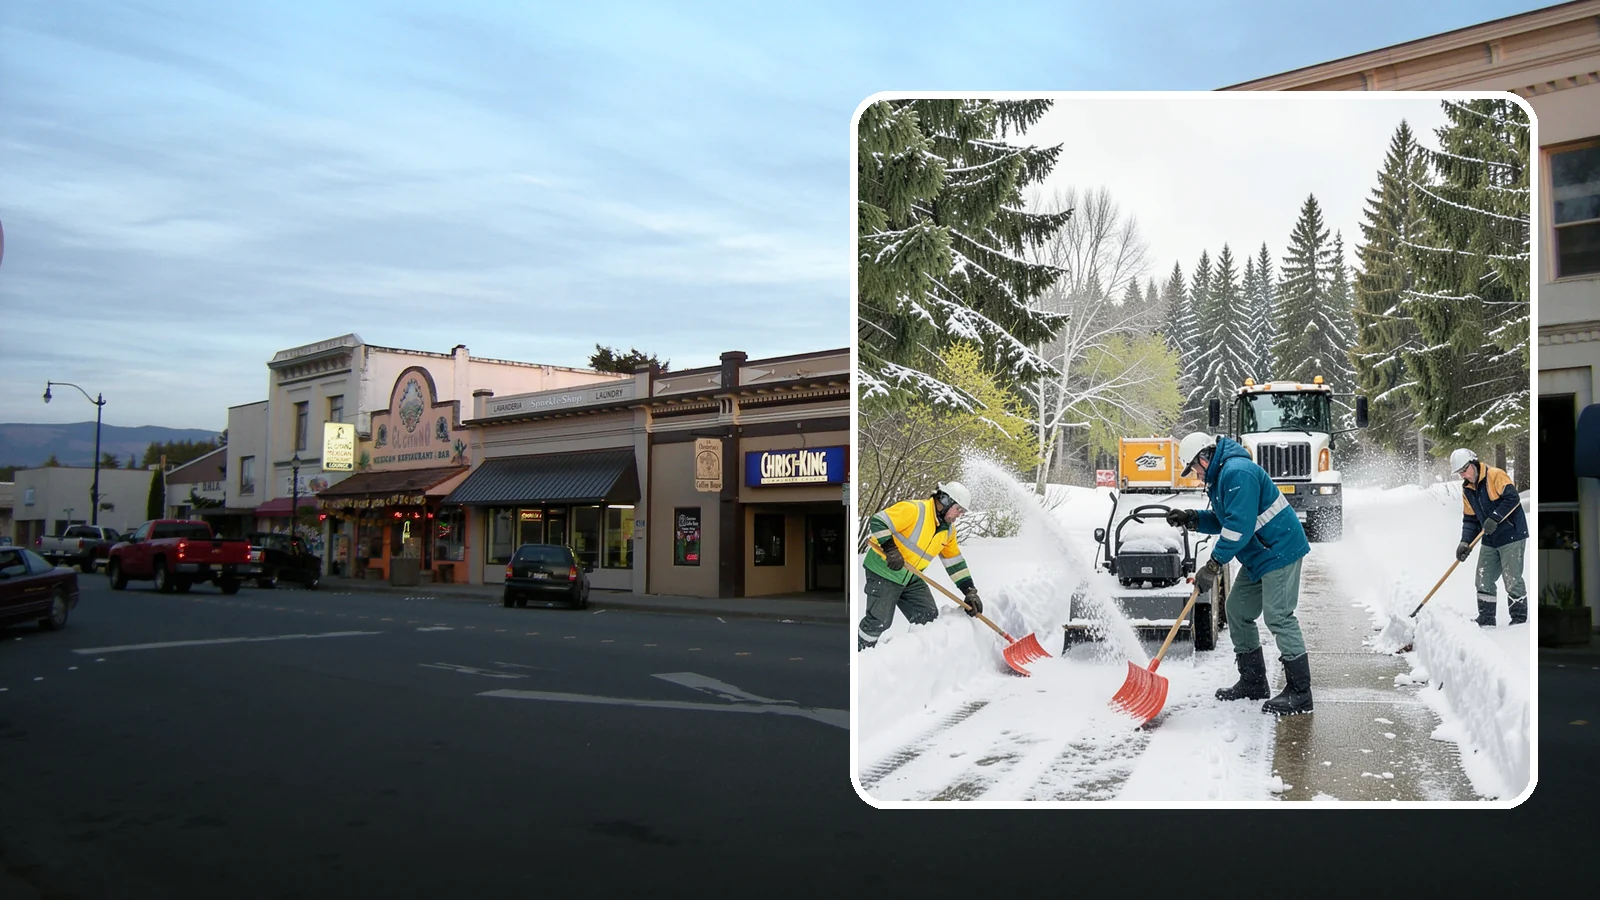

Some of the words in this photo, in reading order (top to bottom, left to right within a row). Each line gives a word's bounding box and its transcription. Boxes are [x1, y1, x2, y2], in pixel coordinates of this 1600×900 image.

[595, 388, 624, 400] LAUNDRY
[493, 402, 522, 413] LAVANDERIA
[530, 398, 560, 409] Sparkle
[562, 394, 582, 405] Shop
[374, 454, 396, 464] MEXICAN
[397, 451, 433, 462] RESTAURANT
[438, 450, 450, 459] BAR
[761, 452, 797, 478] CHRIST
[800, 450, 827, 476] KING
[696, 480, 709, 489] Coffee
[710, 480, 722, 489] House
